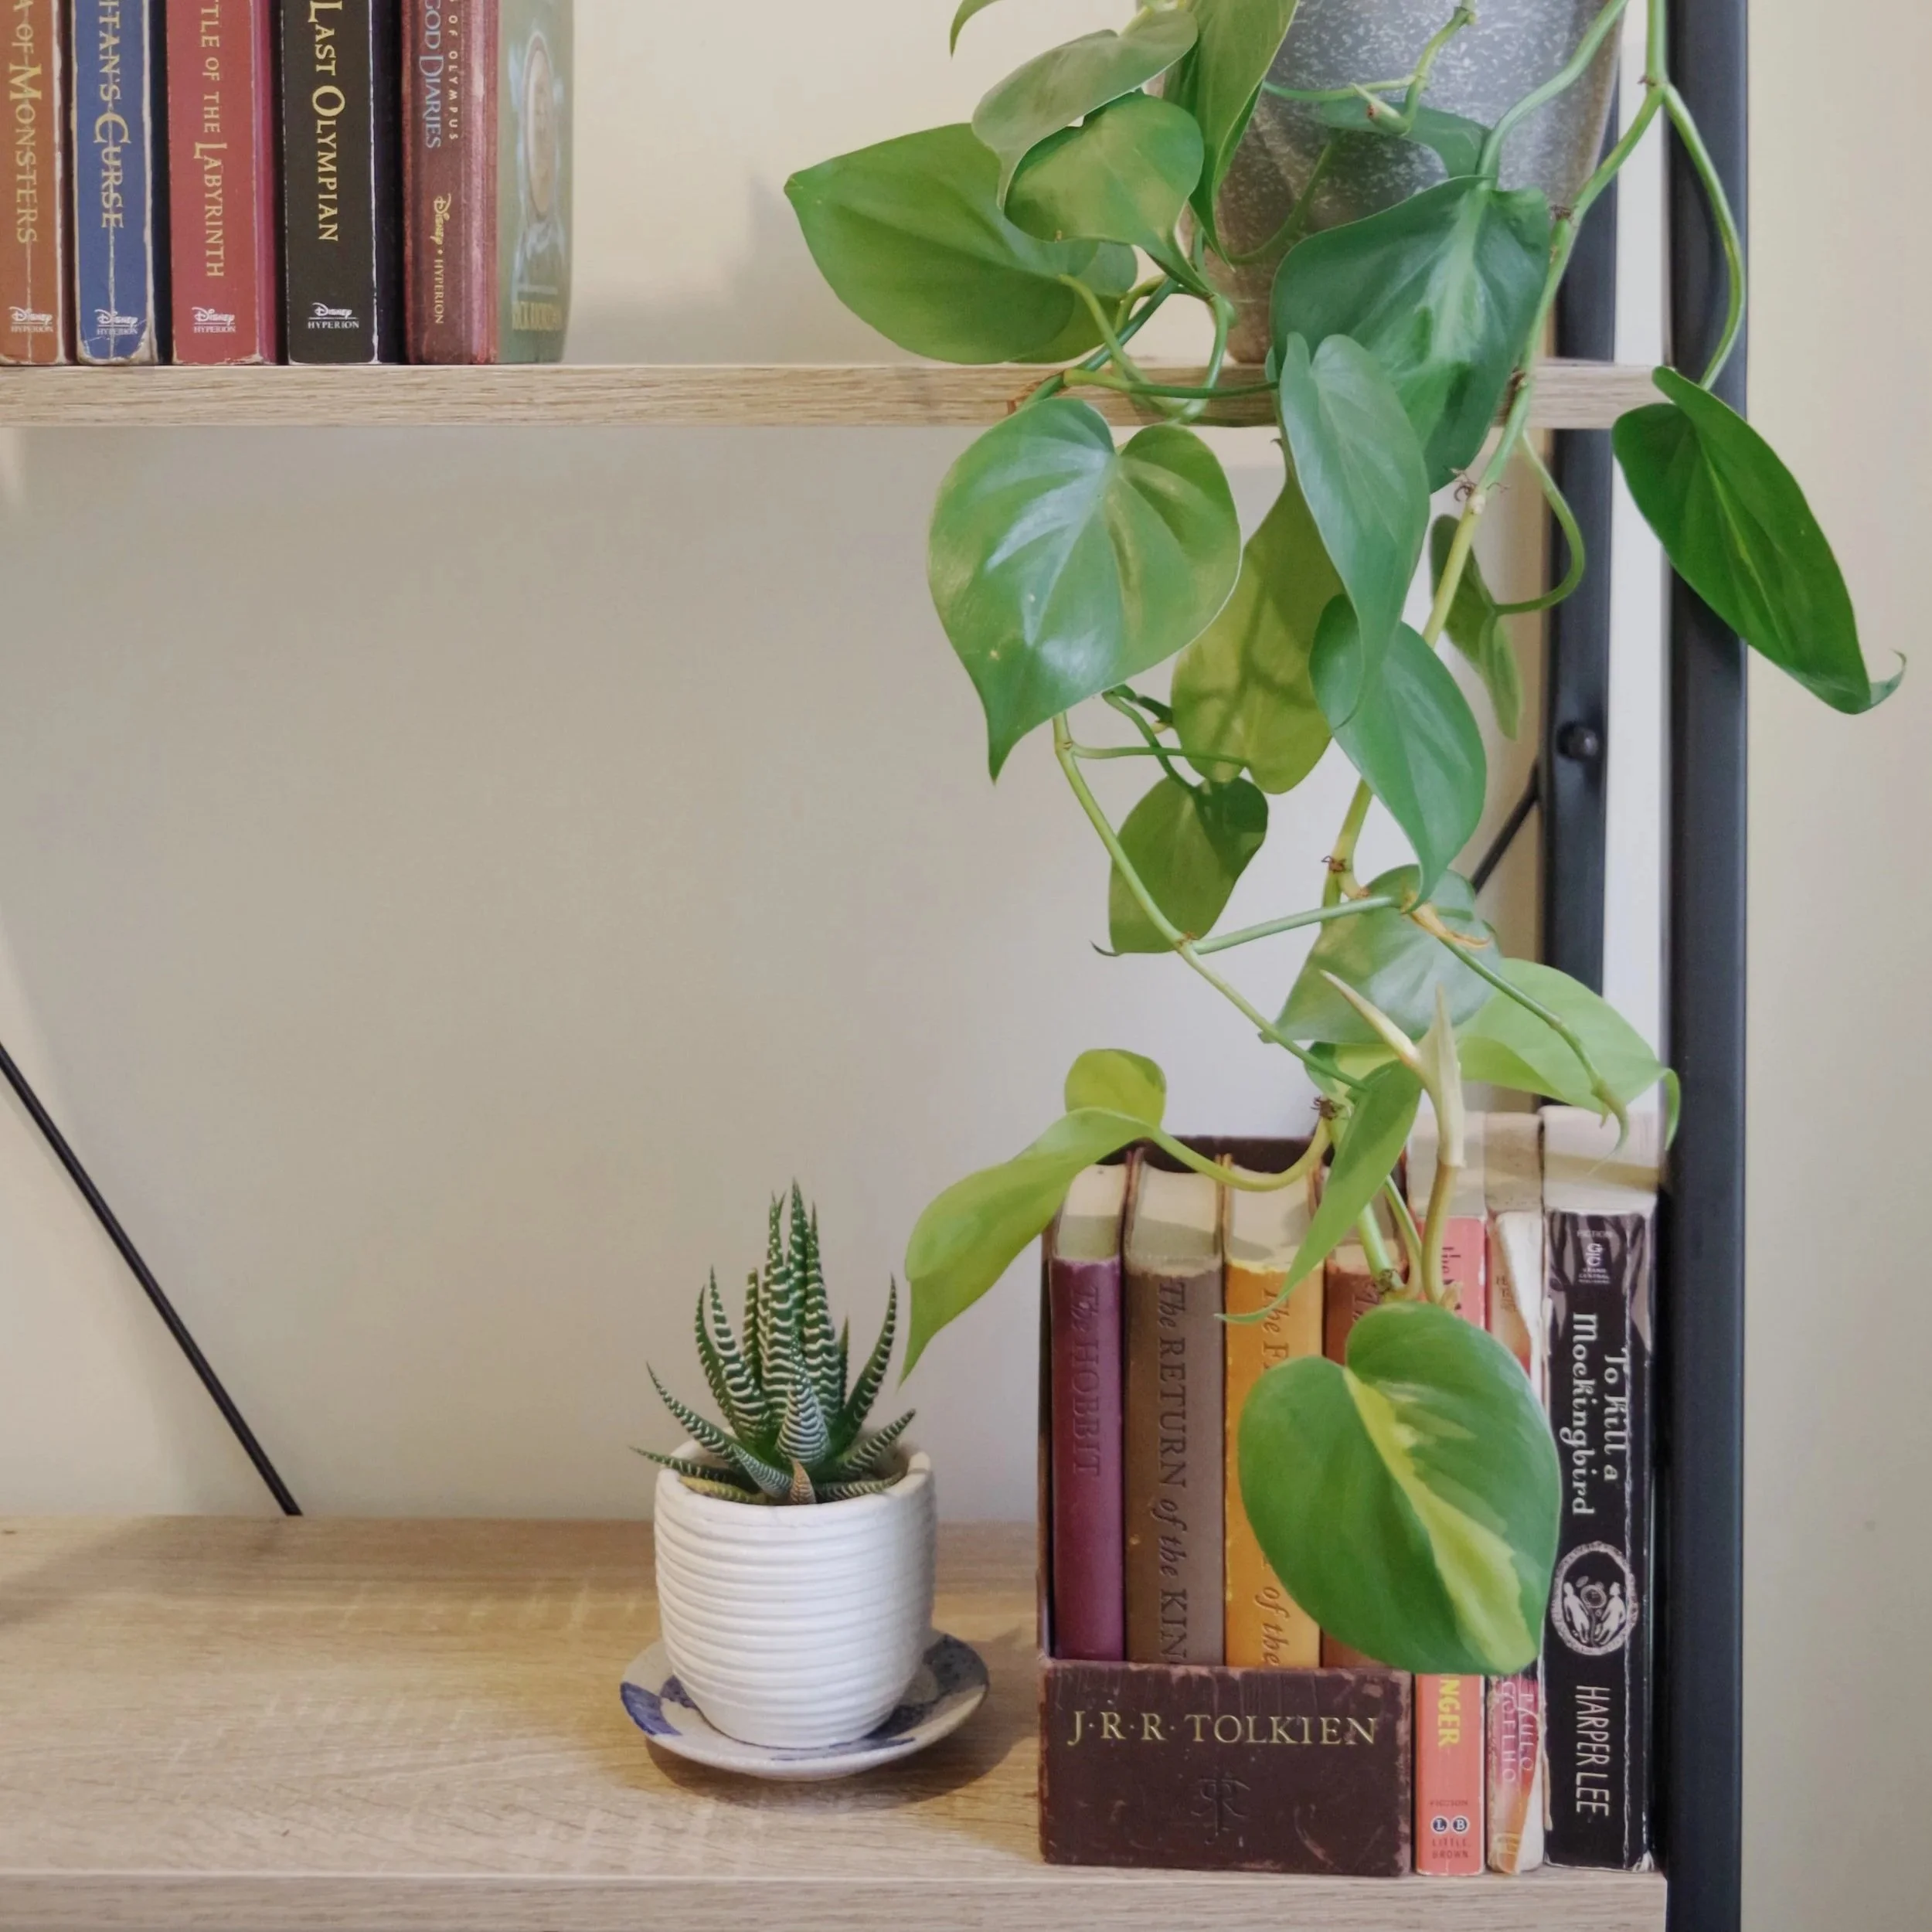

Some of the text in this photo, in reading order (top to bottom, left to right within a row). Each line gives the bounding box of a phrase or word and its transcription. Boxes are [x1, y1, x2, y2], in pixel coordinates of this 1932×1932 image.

[12, 23, 34, 53] OF
[448, 15, 458, 141] OF OLYMPUS
[9, 63, 42, 243] MONSTERS
[194, 0, 227, 277] TLE OF THE LABYRINTH
[308, 1, 345, 242] LAST OLYMPIAN
[419, 56, 444, 148] DIARIES
[94, 112, 132, 229] CURSE
[308, 320, 359, 328] HYPERION
[434, 259, 444, 325] HYPERION
[1070, 1287, 1101, 1478] The HOBBIT
[1559, 1311, 1598, 1515] Mockingbird
[1604, 1347, 1630, 1482] To Kill a
[1151, 1281, 1187, 1665] The RETURN of the KIN
[1254, 1587, 1291, 1666] of the
[1185, 1713, 1377, 1745] TOLKIEN
[1437, 1679, 1461, 1747] NGER
[1502, 1682, 1516, 1781] COELHO
[1576, 1685, 1611, 1817] HARPER LEE
[1432, 1850, 1468, 1859] BROWN
